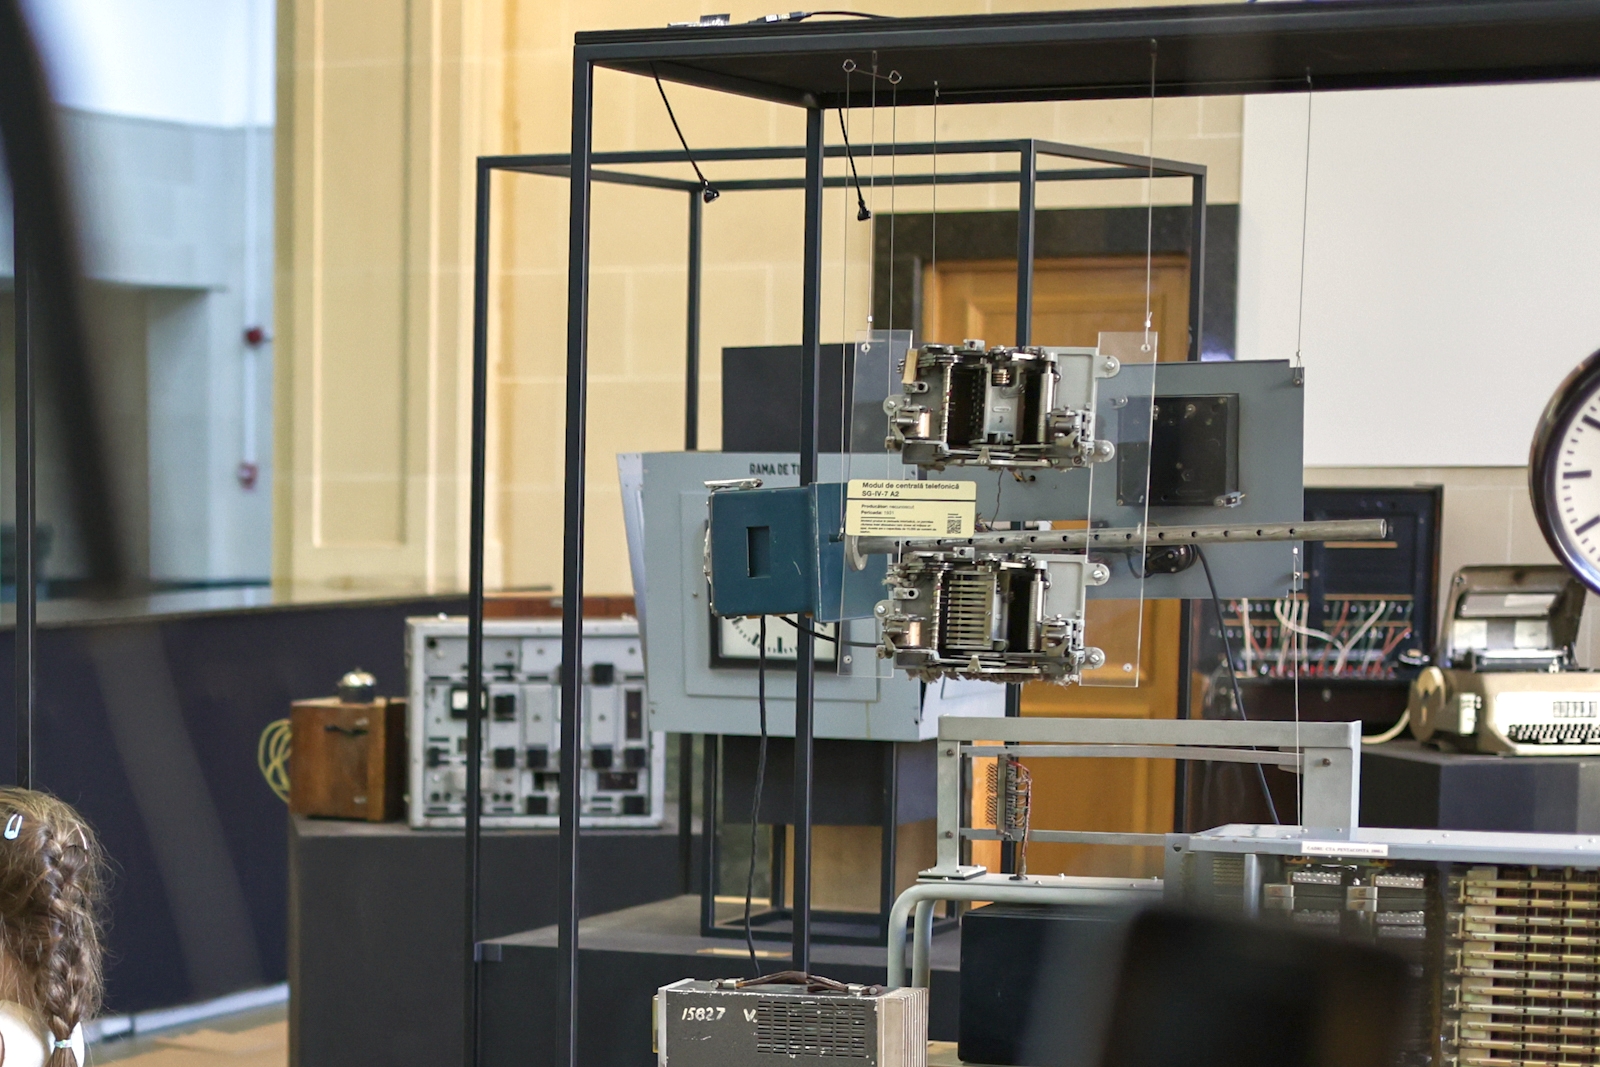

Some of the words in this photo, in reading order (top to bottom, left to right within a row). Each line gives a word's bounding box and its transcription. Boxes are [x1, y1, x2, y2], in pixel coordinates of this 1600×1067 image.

[749, 463, 776, 476] RAMA
[777, 463, 790, 475] DE
[681, 1006, 727, 1021] 15827
